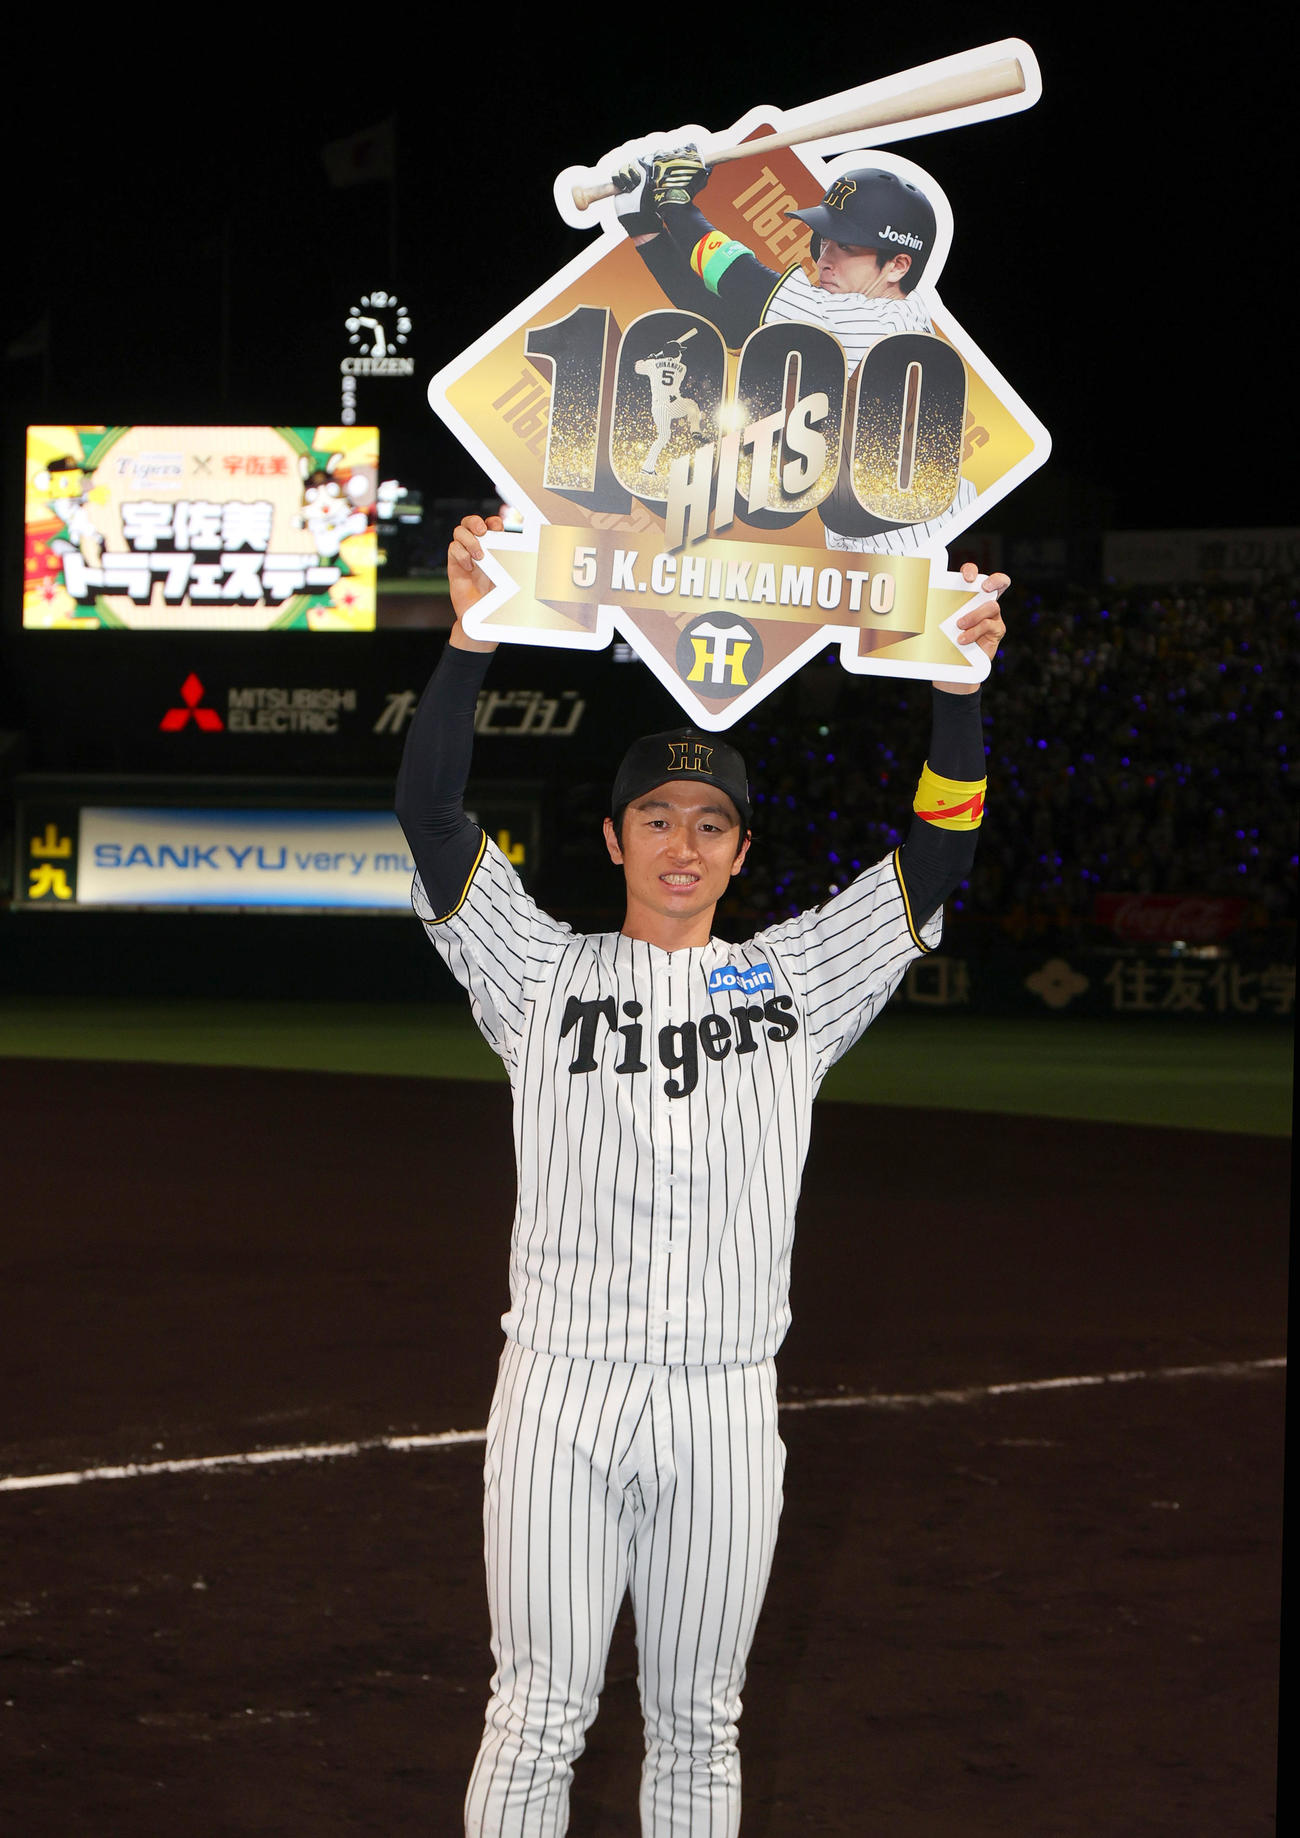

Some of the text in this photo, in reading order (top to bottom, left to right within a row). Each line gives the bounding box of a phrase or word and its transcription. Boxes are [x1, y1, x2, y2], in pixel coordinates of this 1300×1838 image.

[879, 224, 923, 251] Joshin
[340, 357, 414, 377] CITIZEN
[661, 370, 675, 386] 5
[523, 303, 969, 526] 1000
[664, 392, 829, 553] HITS
[121, 501, 274, 551] 宇佐美
[571, 546, 598, 588] 5
[610, 549, 896, 615] K.CHIKAMOTO
[228, 687, 357, 710] MITSUBISHI
[228, 710, 338, 733] ELECTRIC
[94, 843, 287, 871] SANKYU
[294, 849, 367, 877] very
[560, 994, 800, 1099] Tigers
